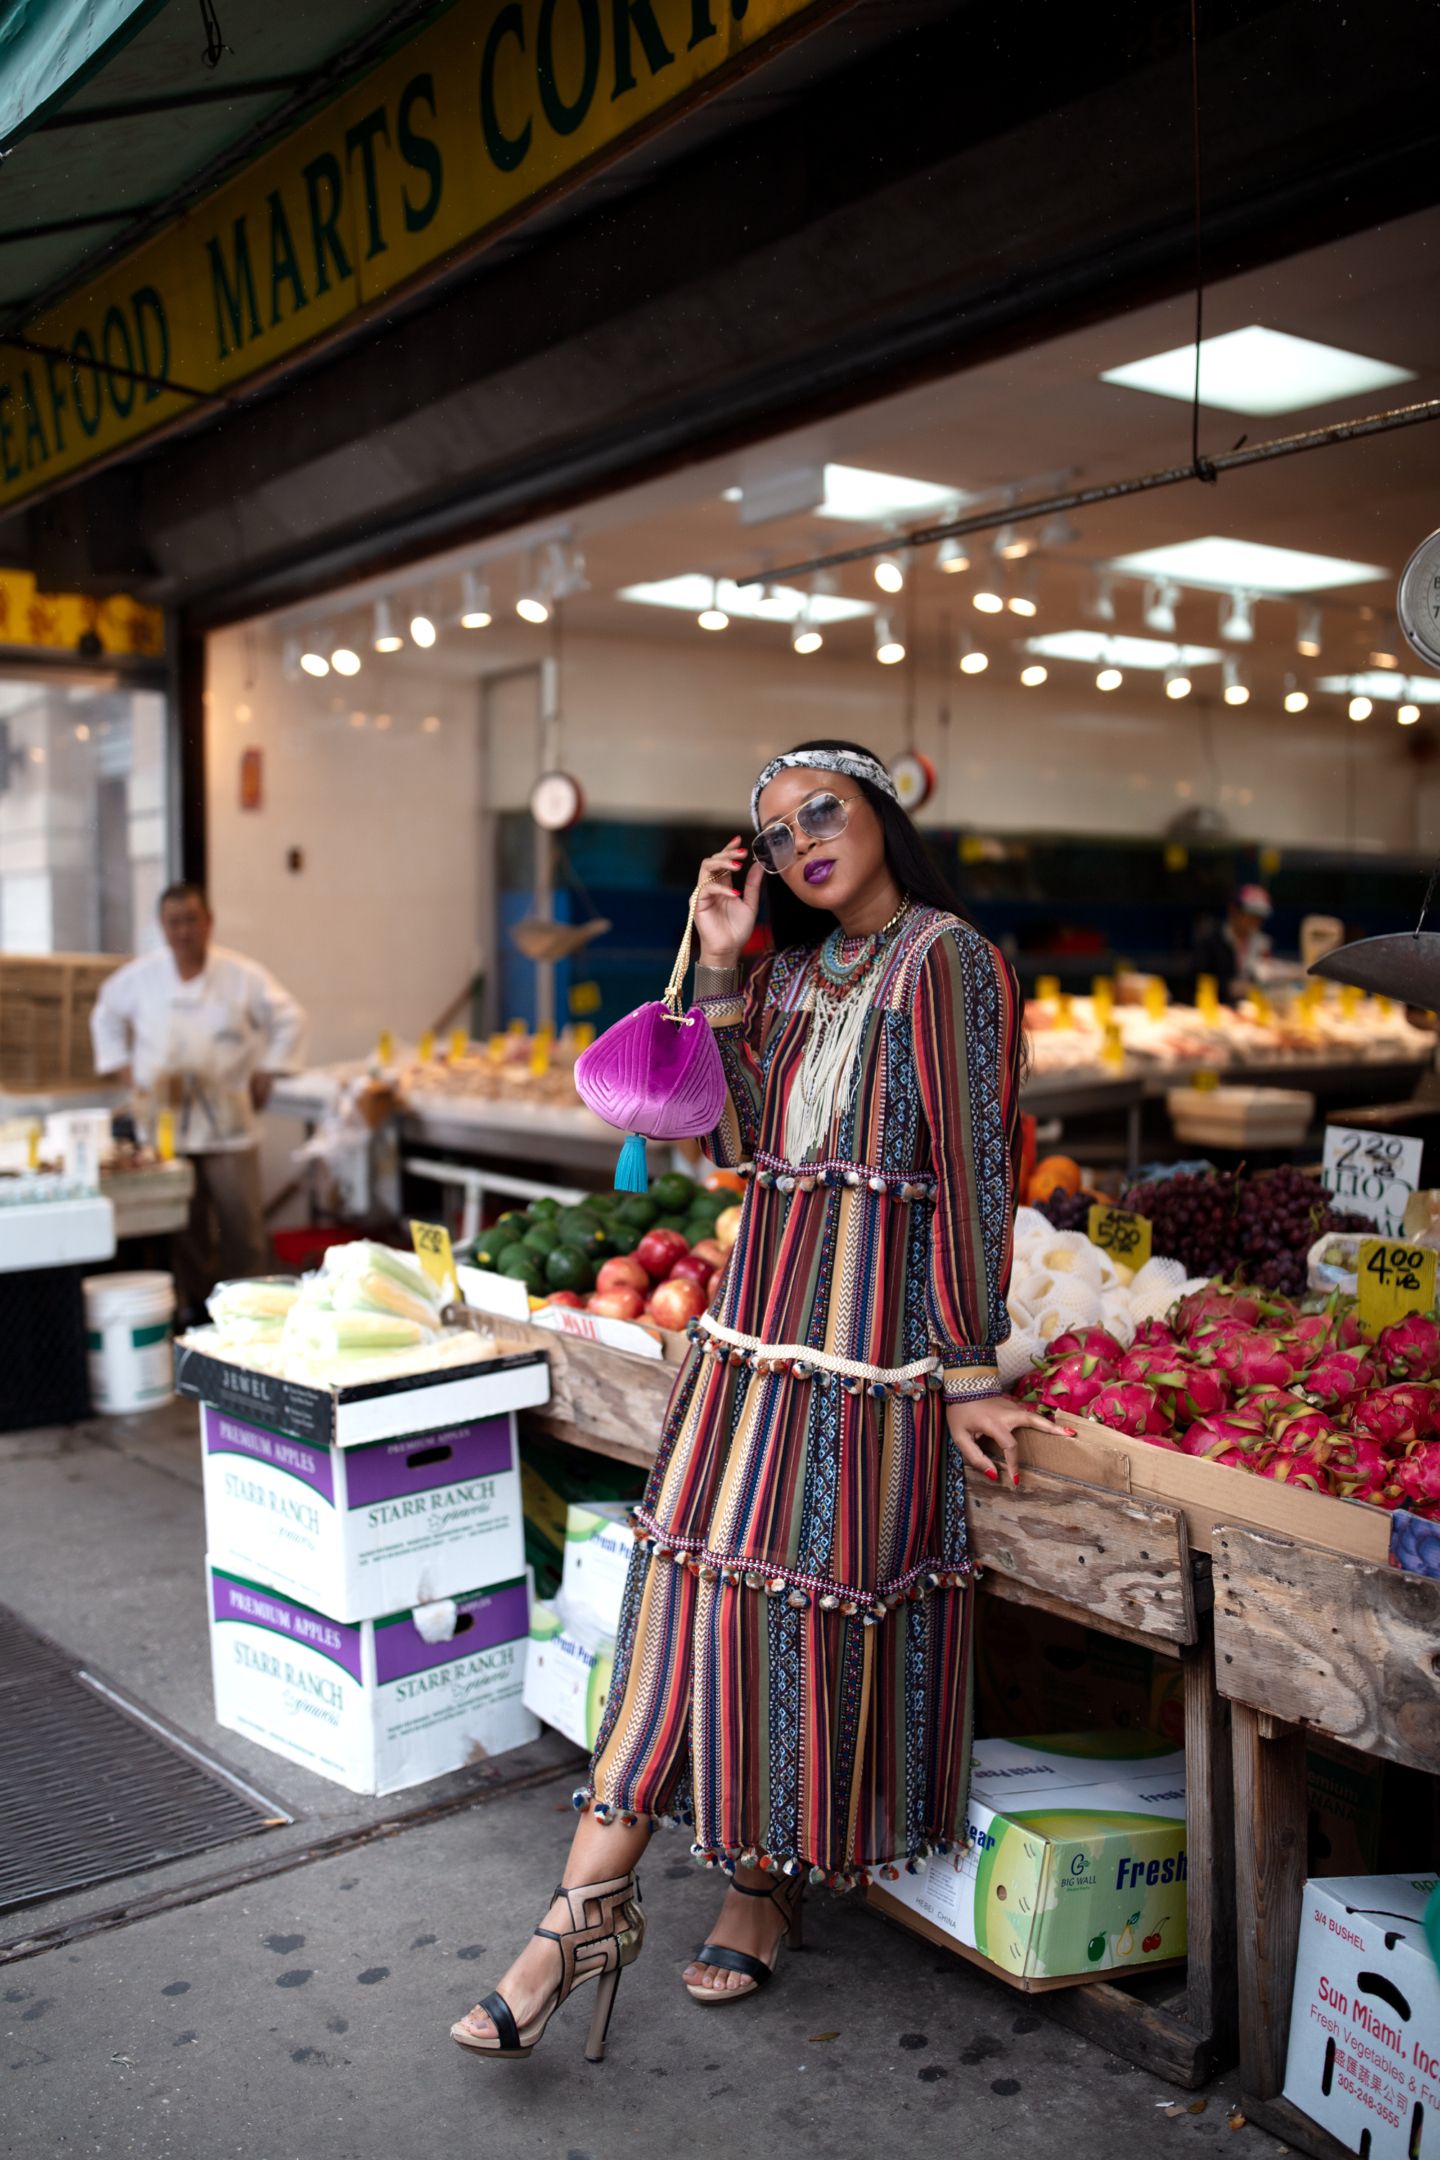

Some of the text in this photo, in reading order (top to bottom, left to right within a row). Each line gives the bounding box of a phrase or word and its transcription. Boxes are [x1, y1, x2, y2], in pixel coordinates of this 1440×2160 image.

[206, 73, 443, 359] MARTS
[1367, 1245, 1424, 1286] 4.00
[222, 1370, 270, 1401] JEWEL
[219, 1420, 316, 1474] PREMIUM APPLES
[387, 1435, 435, 1455] PREMIUM
[437, 1428, 471, 1445] APPLES
[224, 1471, 320, 1535] STARR RANCH
[368, 1480, 496, 1528] STARR RANCH
[229, 1589, 342, 1650] PREMIUM APPLES
[234, 1640, 282, 1680] STARR
[284, 1662, 343, 1711] RANCH
[395, 1646, 515, 1703] STARR RANCH
[1061, 1875, 1096, 1887] BIG WALL
[915, 1897, 957, 1929] HEBEI CHINA
[1314, 1909, 1366, 1952] 3/4 BUSHEL
[1318, 1976, 1348, 2015] Sun
[1352, 1999, 1406, 2059] Miami,
[1310, 2004, 1339, 2037] Fresh
[1344, 2027, 1405, 2085] Vegetables
[1408, 2076, 1416, 2094] &
[1337, 2073, 1400, 2128] 305-248-3555
